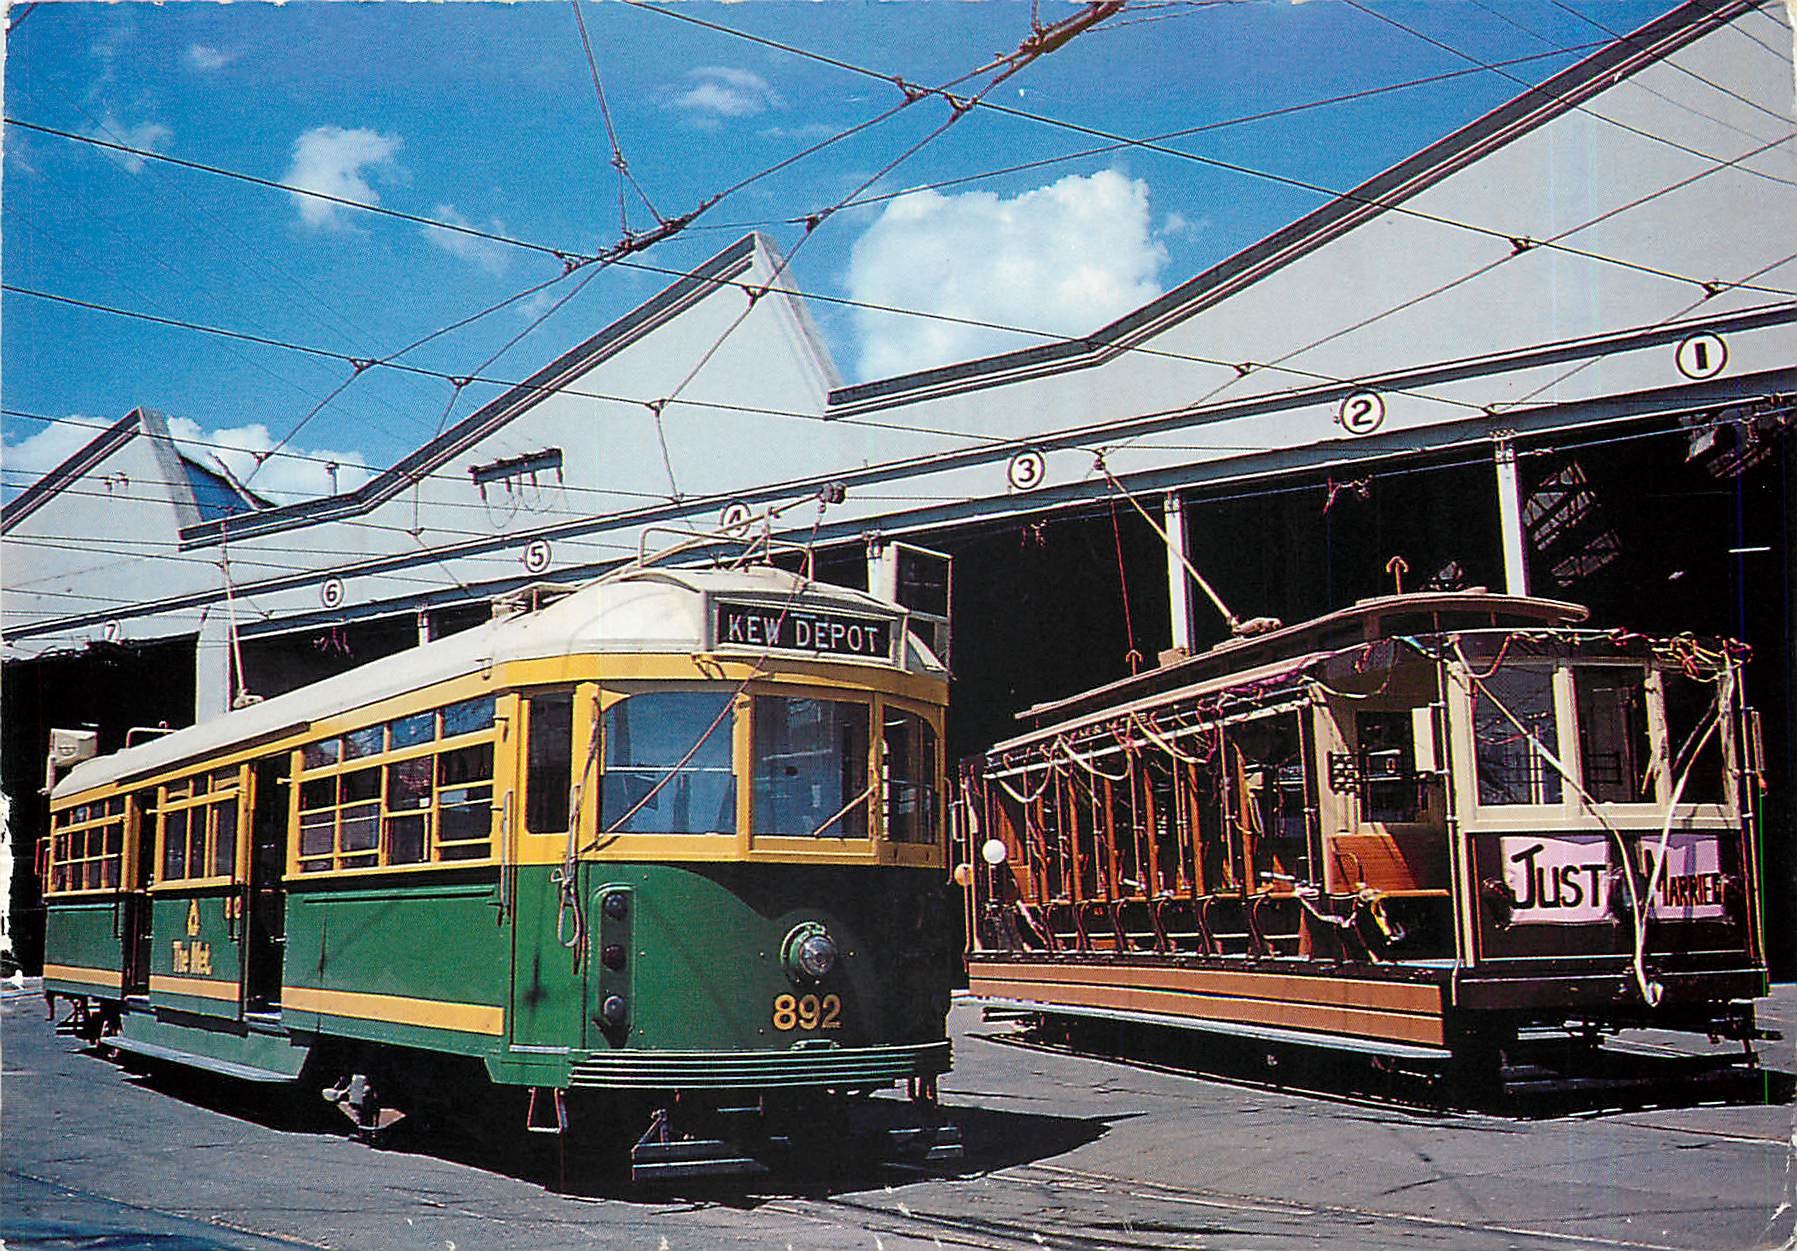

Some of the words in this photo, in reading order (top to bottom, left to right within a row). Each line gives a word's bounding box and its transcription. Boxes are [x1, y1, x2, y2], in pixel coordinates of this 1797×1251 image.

[729, 613, 782, 644] KEW
[795, 619, 878, 652] DEPOT
[1510, 844, 1607, 909] JUST
[772, 993, 842, 1031] 892
